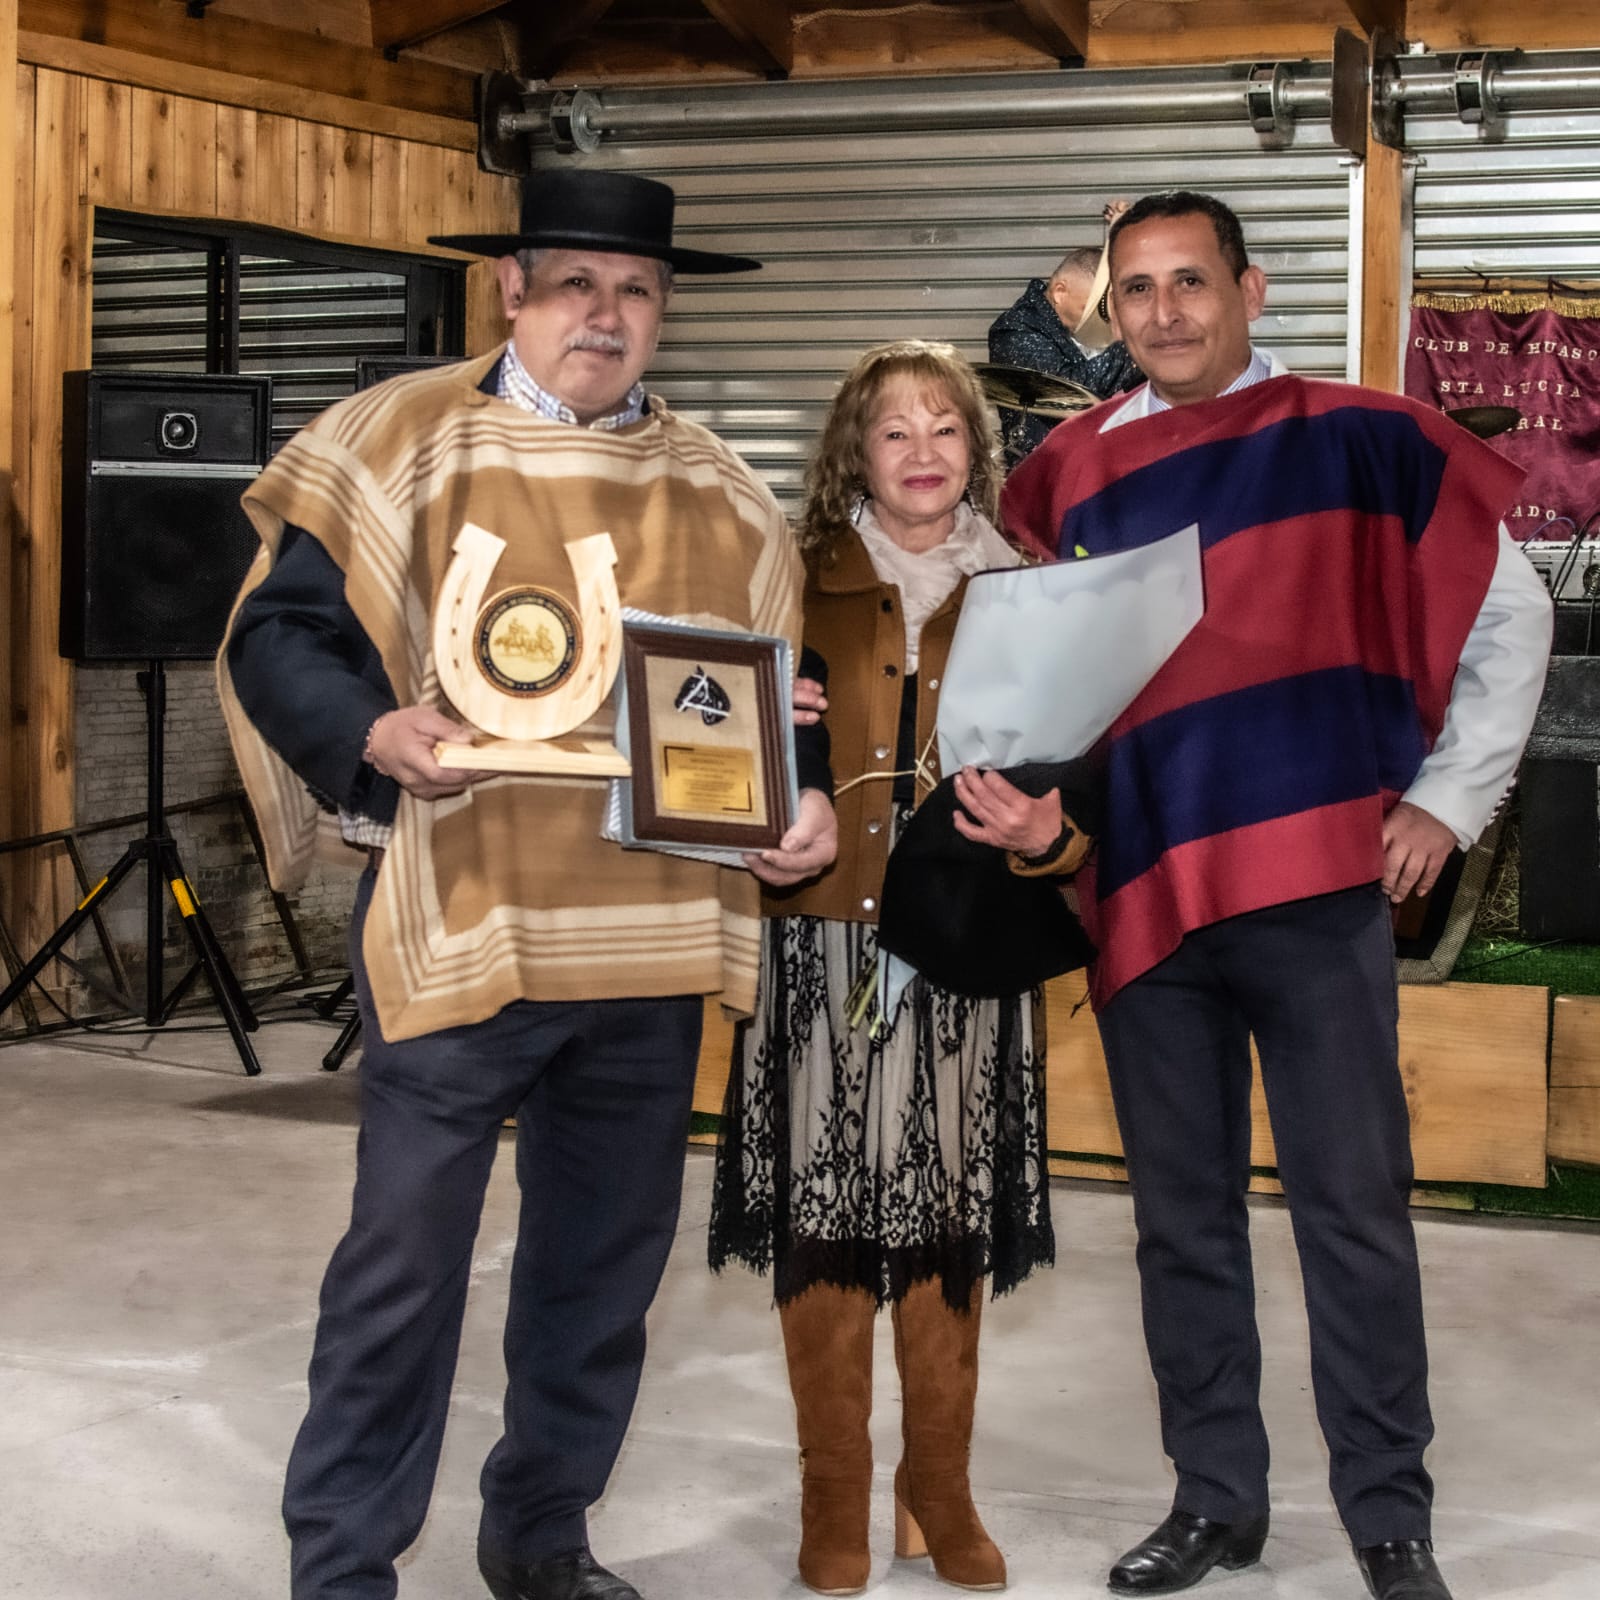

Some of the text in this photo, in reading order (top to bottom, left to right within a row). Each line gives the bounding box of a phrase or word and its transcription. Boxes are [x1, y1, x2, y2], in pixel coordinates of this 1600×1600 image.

[1414, 336, 1598, 361] CLUB DE HUASO
[1440, 380, 1581, 398] STA LUCIA
[1507, 415, 1563, 432] RAL
[1503, 505, 1556, 521] ADO
